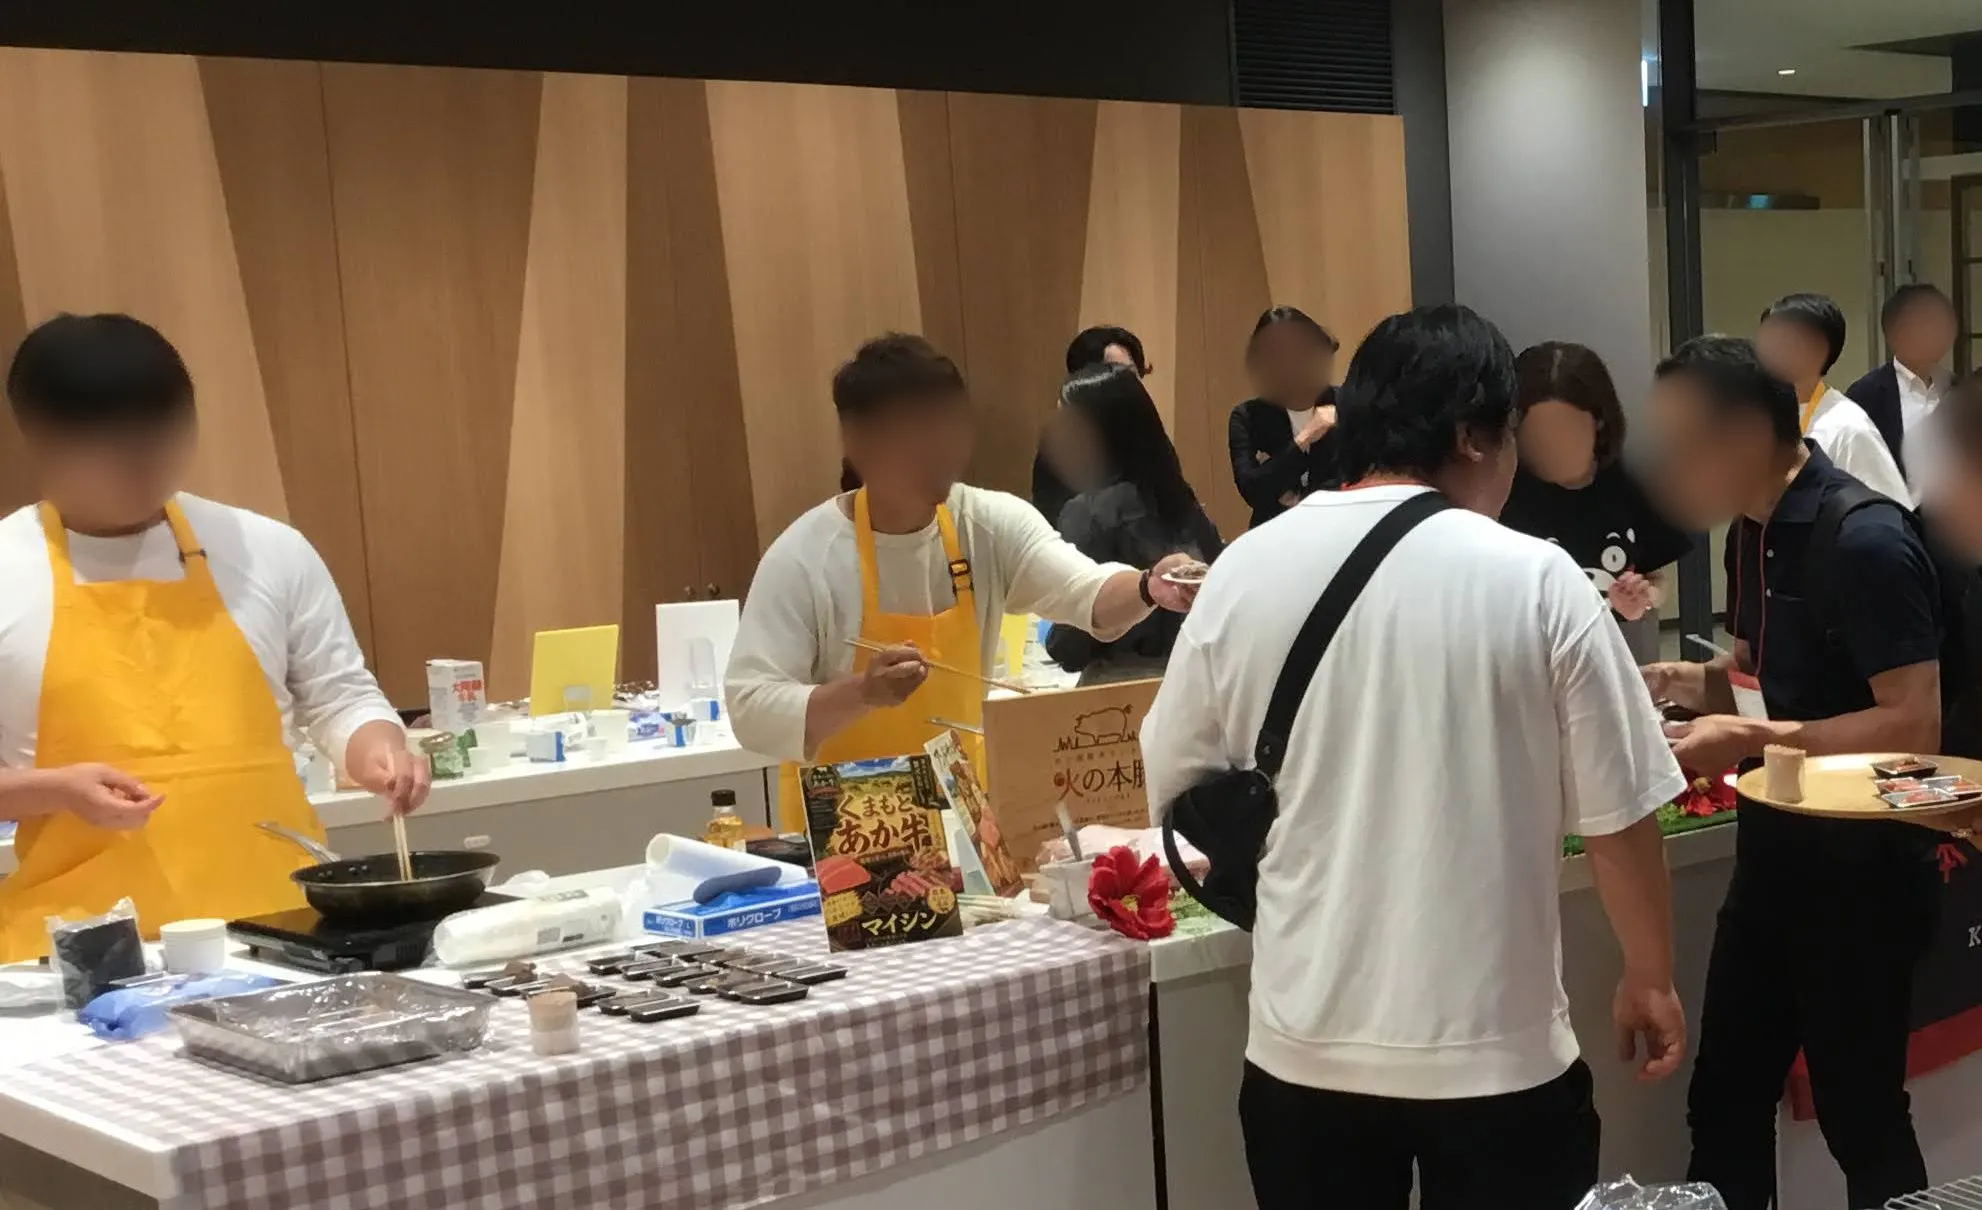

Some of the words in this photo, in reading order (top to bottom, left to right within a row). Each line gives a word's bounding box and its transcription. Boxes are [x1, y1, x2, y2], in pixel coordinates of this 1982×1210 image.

[839, 794, 913, 820] くまもと
[836, 813, 928, 855] あか牛
[861, 911, 937, 936] マイシン
